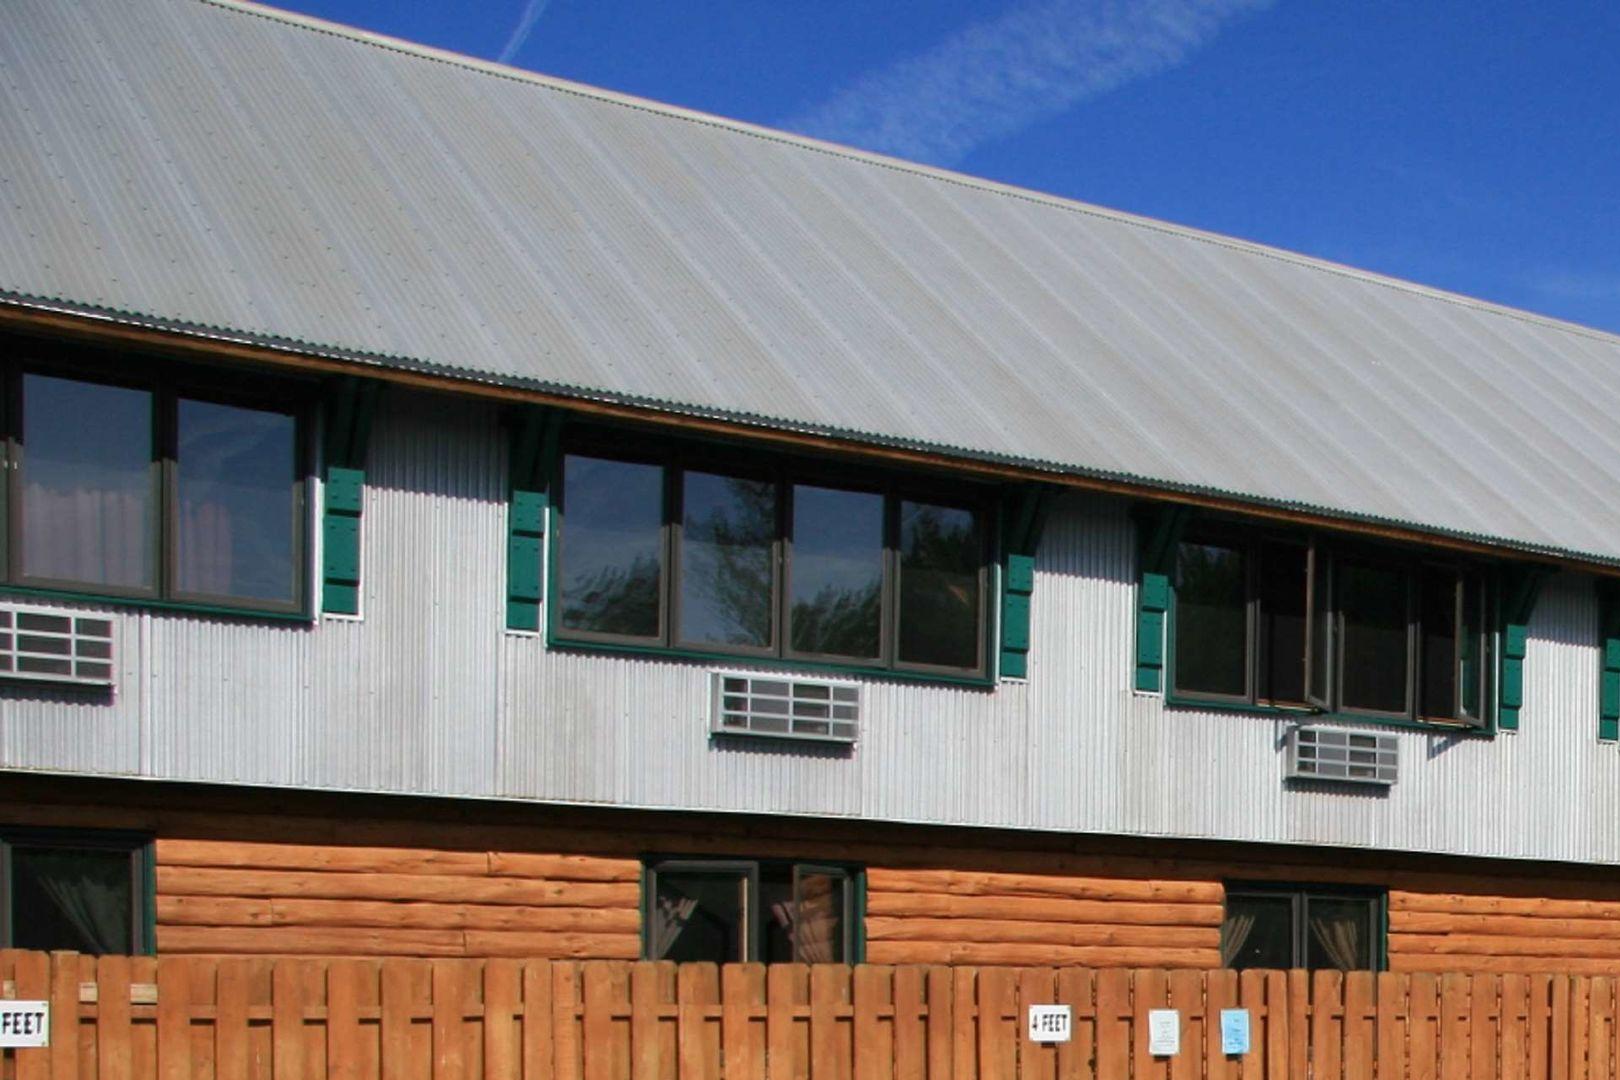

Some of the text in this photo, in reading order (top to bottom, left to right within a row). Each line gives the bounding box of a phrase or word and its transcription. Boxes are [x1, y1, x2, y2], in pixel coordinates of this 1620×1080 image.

[2, 1012, 44, 1035] FEET
[1032, 1014, 1068, 1032] 4 FEET
